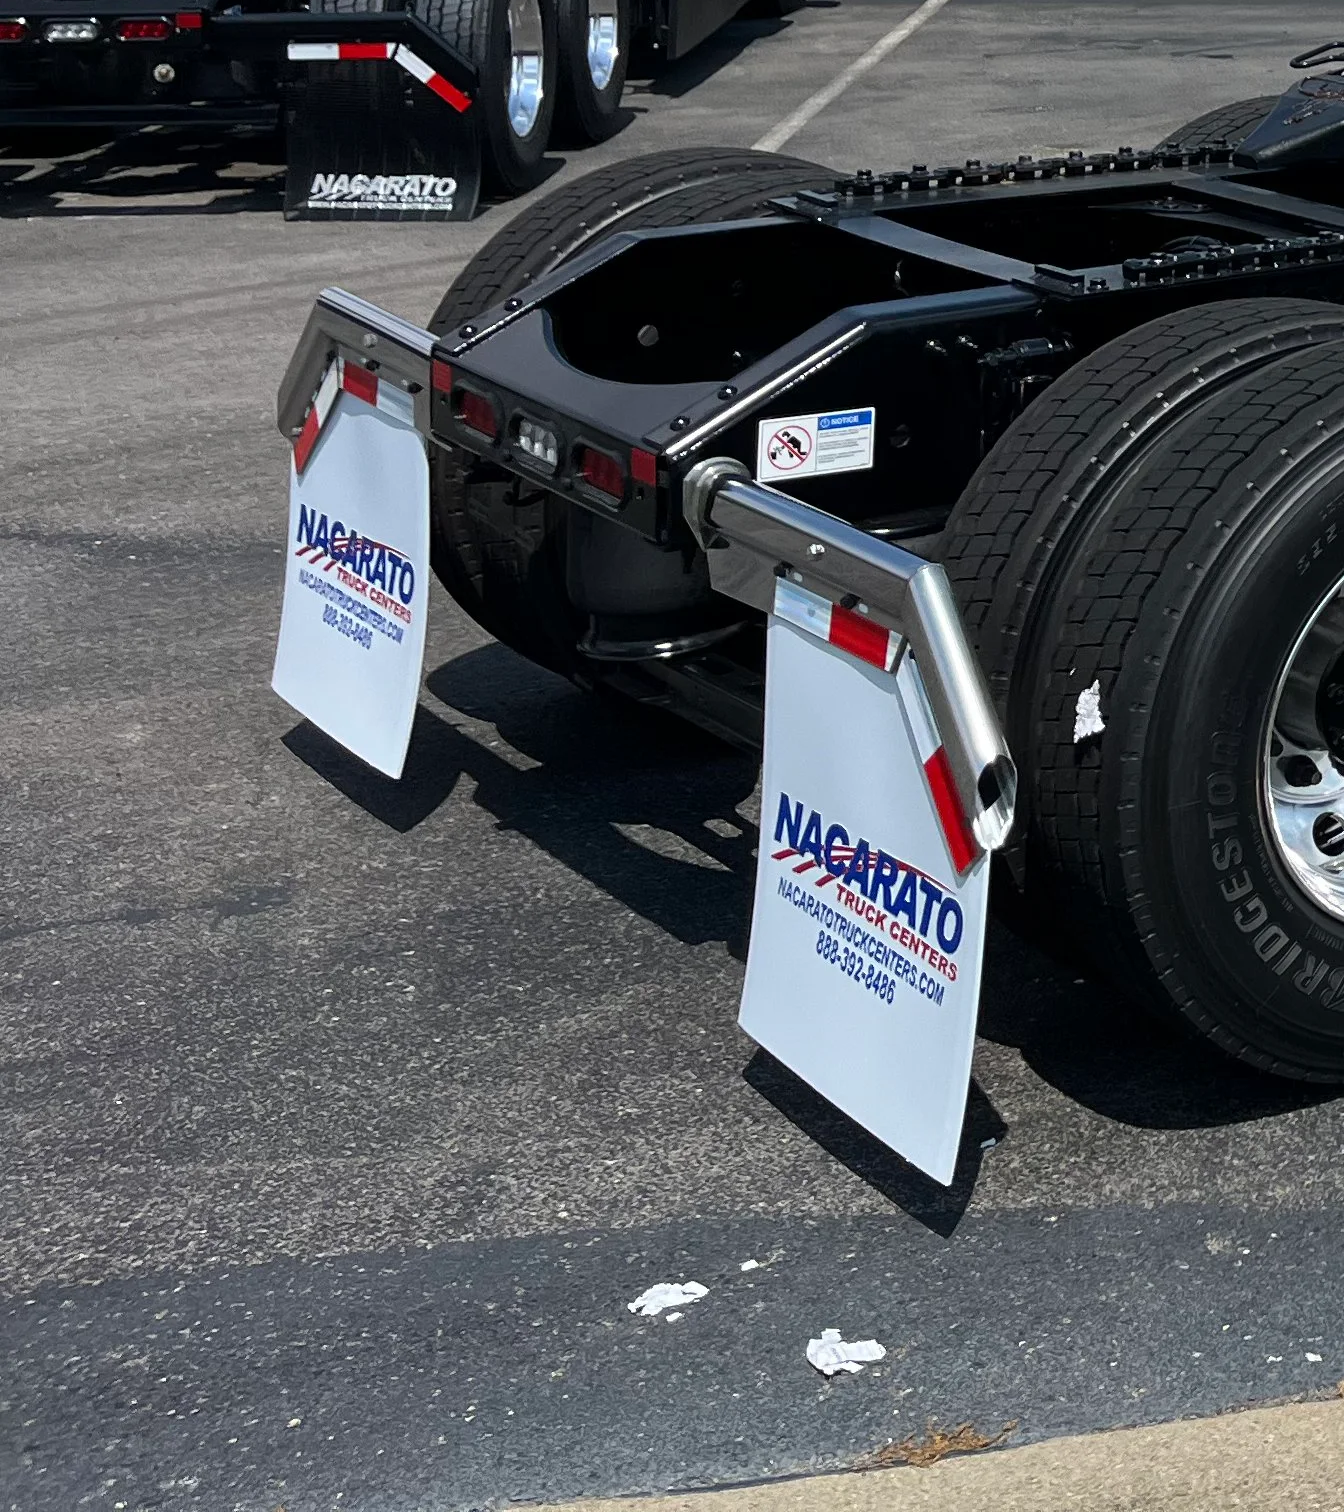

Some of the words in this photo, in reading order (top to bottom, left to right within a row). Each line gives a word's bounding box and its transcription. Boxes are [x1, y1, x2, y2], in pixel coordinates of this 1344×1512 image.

[310, 173, 457, 196] NACARATO
[830, 414, 859, 426] NOTICE
[296, 503, 415, 606] NACARATO
[337, 566, 369, 598] TRUCK
[369, 587, 412, 625] CENTERS
[773, 791, 964, 955] NACARATO
[777, 875, 945, 1007] NACARATOTRUCKCENTERS.COM
[815, 929, 897, 1005] 888-392-8486
[836, 883, 888, 932] TRUCK
[889, 921, 958, 982] CENTERS
